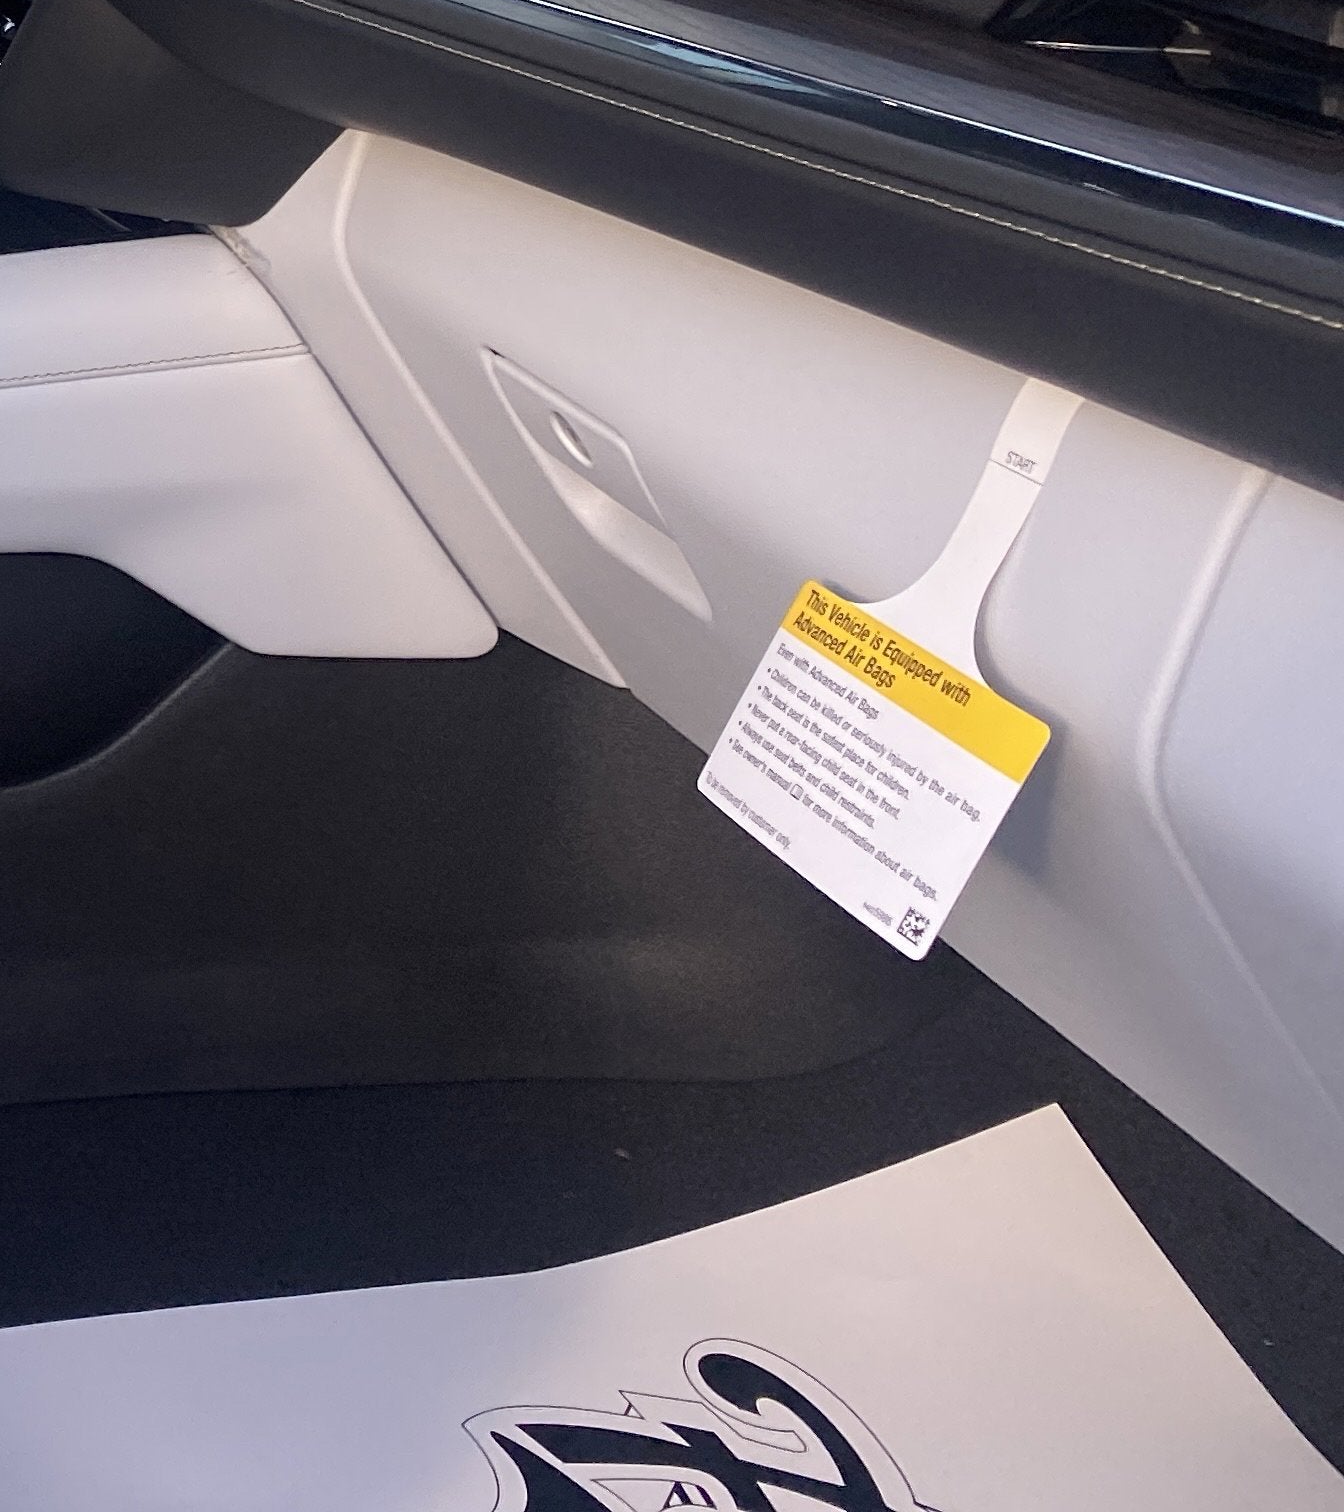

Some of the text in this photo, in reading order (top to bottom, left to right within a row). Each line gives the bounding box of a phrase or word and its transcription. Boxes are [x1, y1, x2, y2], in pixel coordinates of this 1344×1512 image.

[777, 643, 879, 719] Even with Advanced Air Bags
[793, 611, 895, 687] Advanced Air Bags
[807, 590, 971, 706] This Vehicle is Equipped with
[741, 722, 875, 829] Always use seat belts and child restraints.
[751, 704, 770, 722] Never
[767, 719, 781, 732] put
[784, 731, 822, 764] rear-facing
[821, 758, 842, 776] child
[839, 771, 858, 788] seat
[865, 788, 879, 803] the
[879, 797, 900, 820] front.
[771, 669, 797, 695] Children
[797, 690, 811, 704] can
[821, 704, 844, 725] killed
[851, 727, 886, 758] seriously
[886, 750, 918, 777] injured
[916, 770, 929, 786] by
[928, 779, 945, 796] the
[945, 792, 960, 805] air
[960, 800, 980, 822] bag.
[772, 695, 788, 713] back
[787, 708, 804, 724] seat
[809, 722, 822, 737] the
[821, 732, 846, 753] safest
[842, 748, 865, 768] place
[865, 761, 879, 776] for
[877, 772, 909, 800] children.
[743, 750, 767, 773] owner's
[766, 768, 792, 791] manual
[813, 804, 832, 823] more
[832, 816, 875, 855] information
[875, 851, 900, 873] about
[913, 876, 936, 901] bags.
